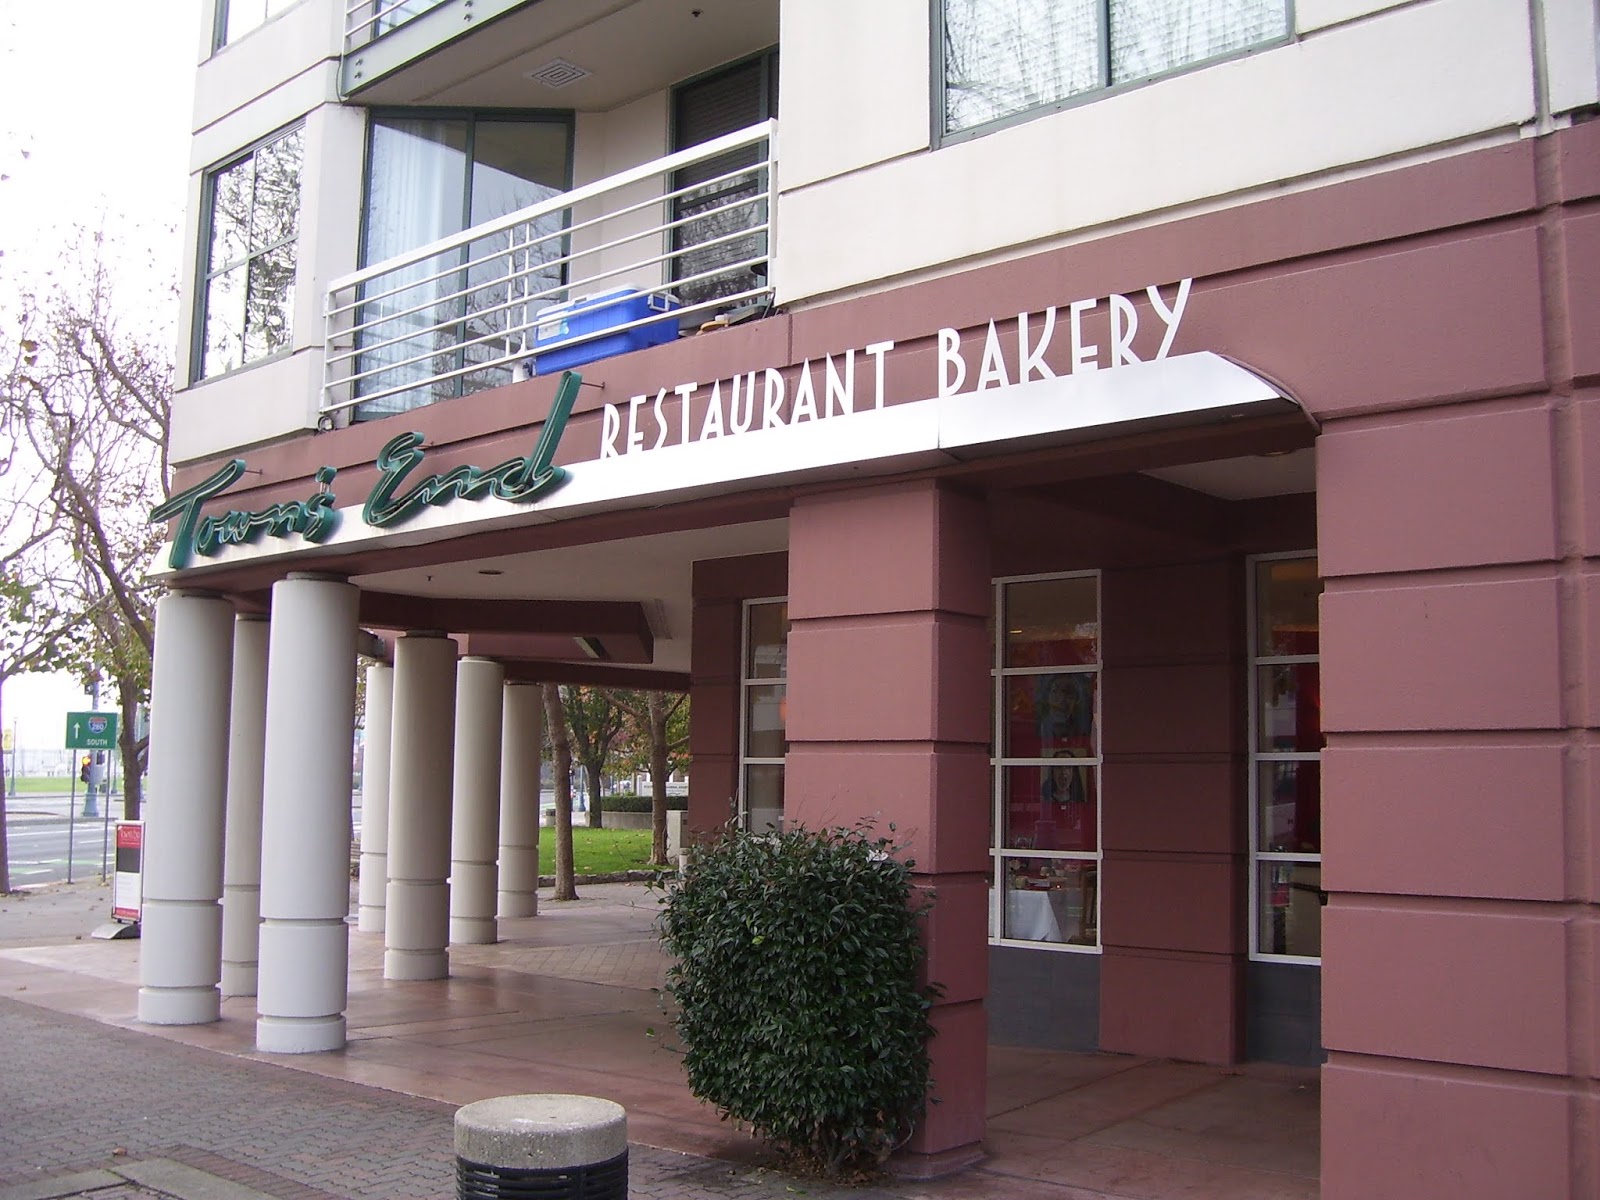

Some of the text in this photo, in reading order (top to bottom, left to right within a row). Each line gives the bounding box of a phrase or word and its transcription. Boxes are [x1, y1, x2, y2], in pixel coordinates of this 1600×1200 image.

[361, 370, 573, 528] End
[600, 277, 1192, 459] RESTAURANT BAKERY
